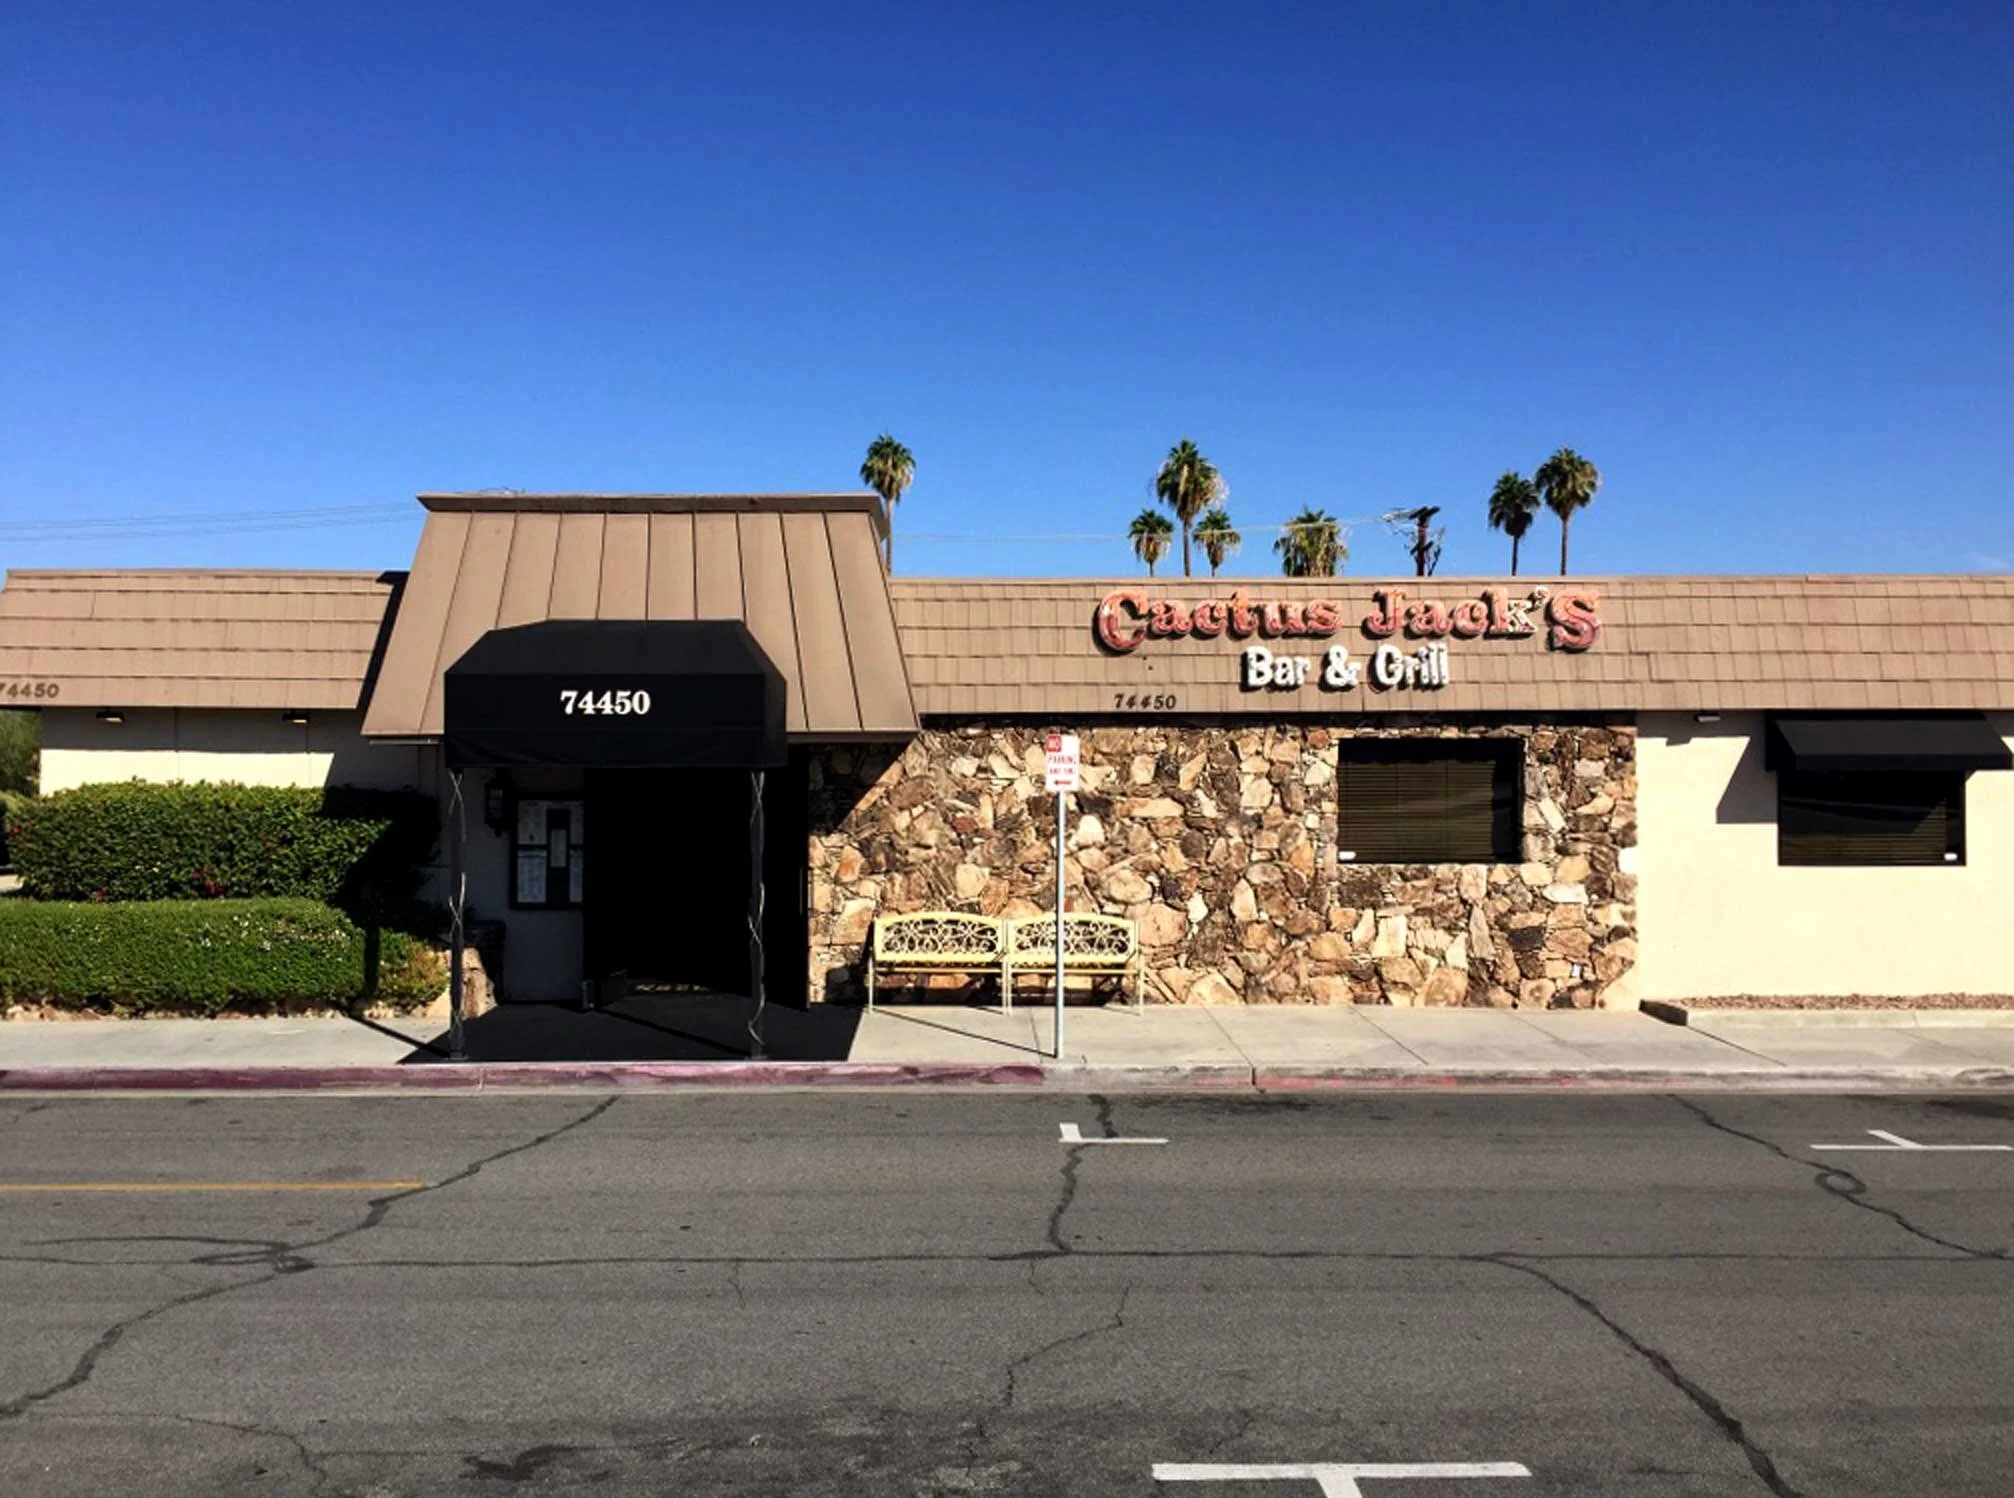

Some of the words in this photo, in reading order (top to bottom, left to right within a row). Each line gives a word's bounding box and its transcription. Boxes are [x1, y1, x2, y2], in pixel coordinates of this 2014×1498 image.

[1096, 588, 1343, 652] Cactus
[1245, 646, 1311, 688] Bar
[1323, 644, 1361, 688] &
[1373, 643, 1449, 688] Grill
[560, 689, 651, 715] 74450
[1113, 693, 1177, 710] 74450
